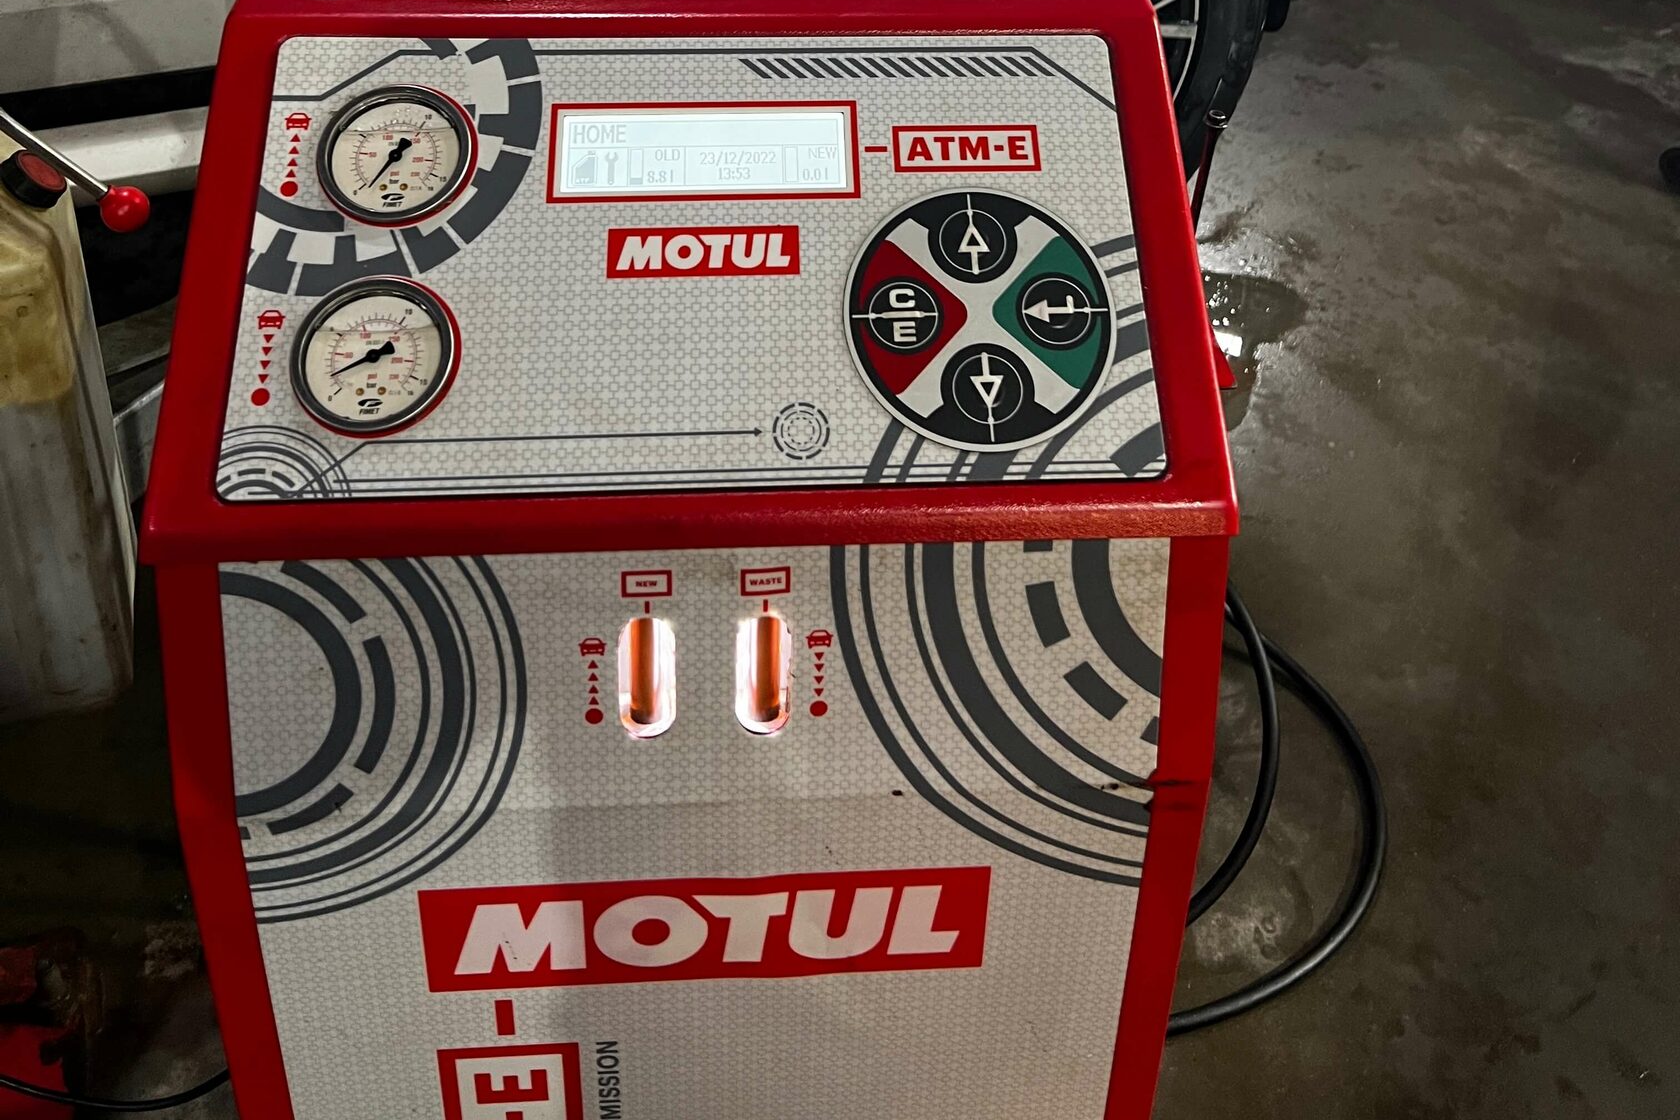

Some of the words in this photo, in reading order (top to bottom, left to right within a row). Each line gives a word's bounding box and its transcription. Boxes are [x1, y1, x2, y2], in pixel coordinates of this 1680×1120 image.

[573, 123, 627, 144] HOME
[654, 148, 681, 162] OLD
[807, 146, 837, 160] NEW
[907, 136, 1029, 161] ATM-E
[699, 150, 777, 167] 23/12/2022
[718, 166, 752, 181] 13:53
[615, 233, 791, 271] MOTUL
[635, 580, 657, 588] NEW
[749, 577, 782, 586] WASTE
[453, 884, 961, 975] MOTUL
[596, 1040, 622, 1120] MISSION
